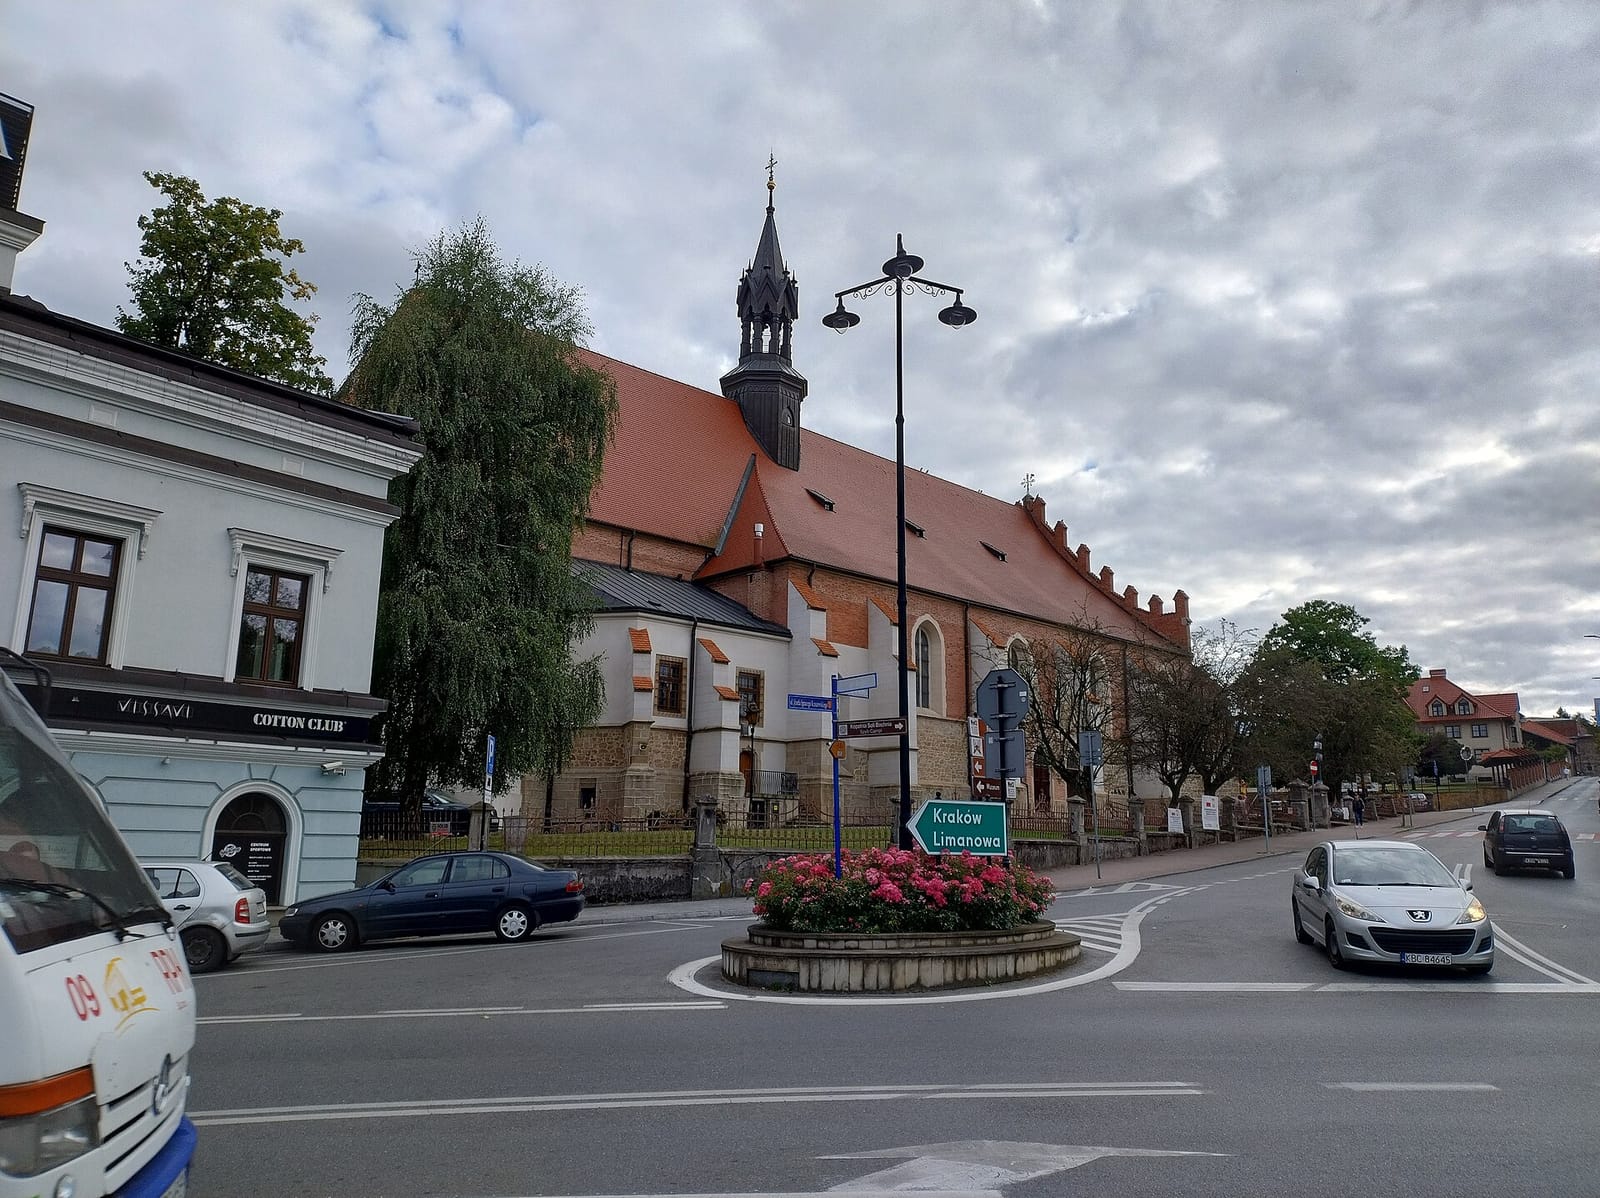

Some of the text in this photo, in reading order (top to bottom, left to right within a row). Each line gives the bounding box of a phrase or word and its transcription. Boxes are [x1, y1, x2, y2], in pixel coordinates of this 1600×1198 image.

[118, 699, 191, 719] VISSAVI
[252, 712, 344, 733] COTTON CLUB
[933, 807, 982, 825] Kraków
[933, 831, 1001, 848] Limanowa
[1405, 954, 1451, 964] KBC 84645
[65, 974, 101, 1021] 09
